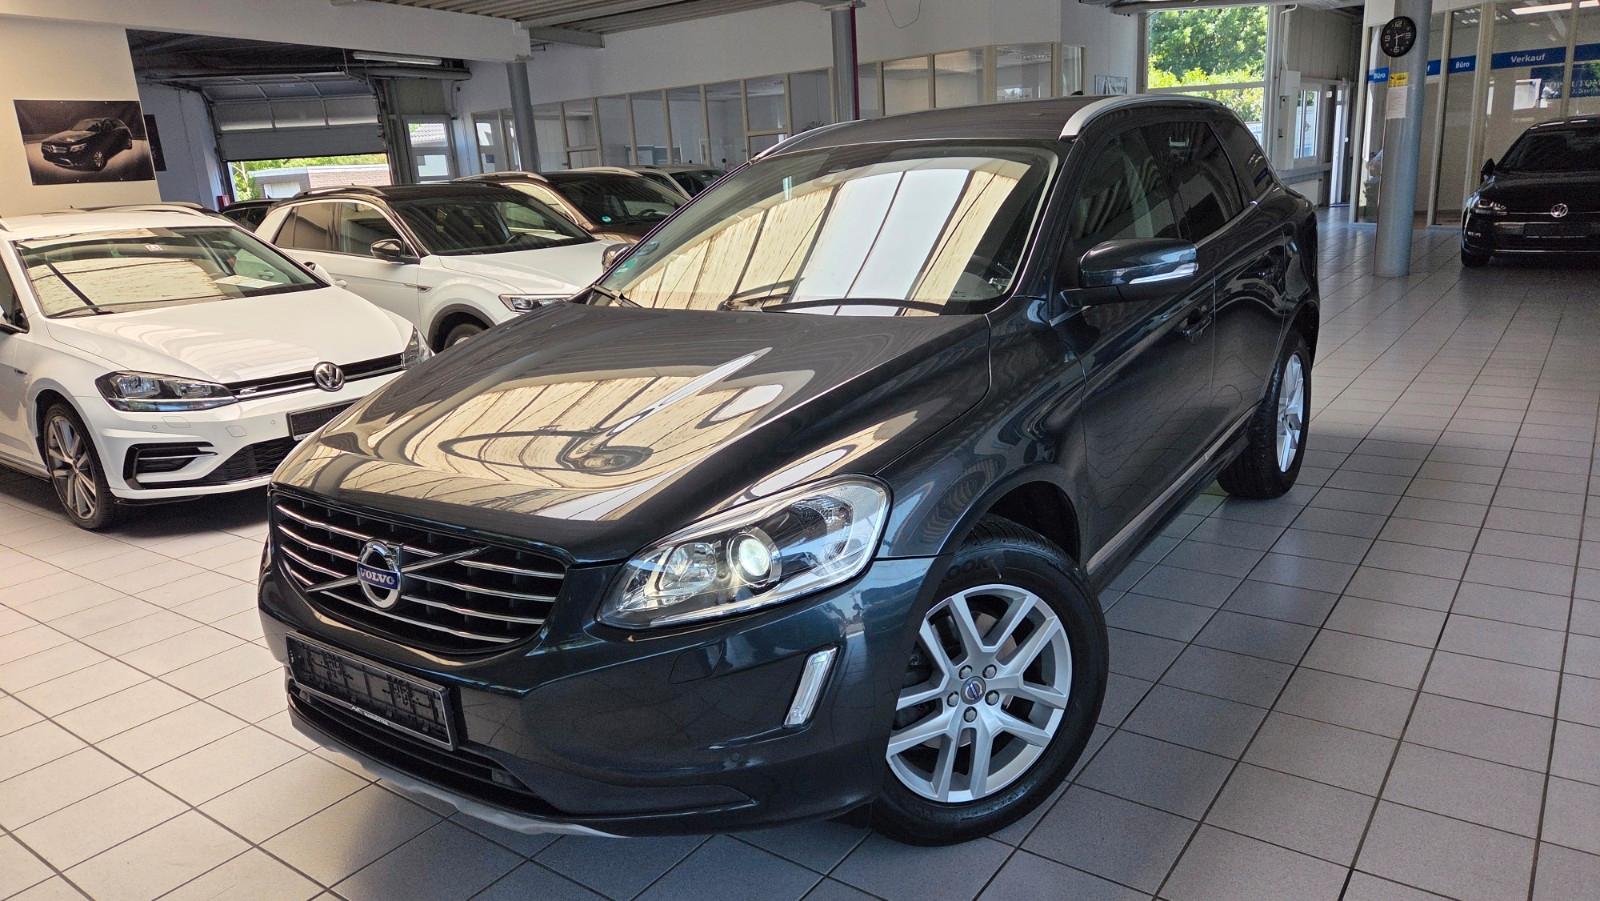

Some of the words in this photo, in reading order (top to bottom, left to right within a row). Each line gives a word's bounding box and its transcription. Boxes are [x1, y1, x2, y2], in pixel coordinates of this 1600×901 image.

[1510, 53, 1546, 63] Verkauf
[1455, 61, 1470, 69] Büro
[359, 567, 395, 586] VOLVO
